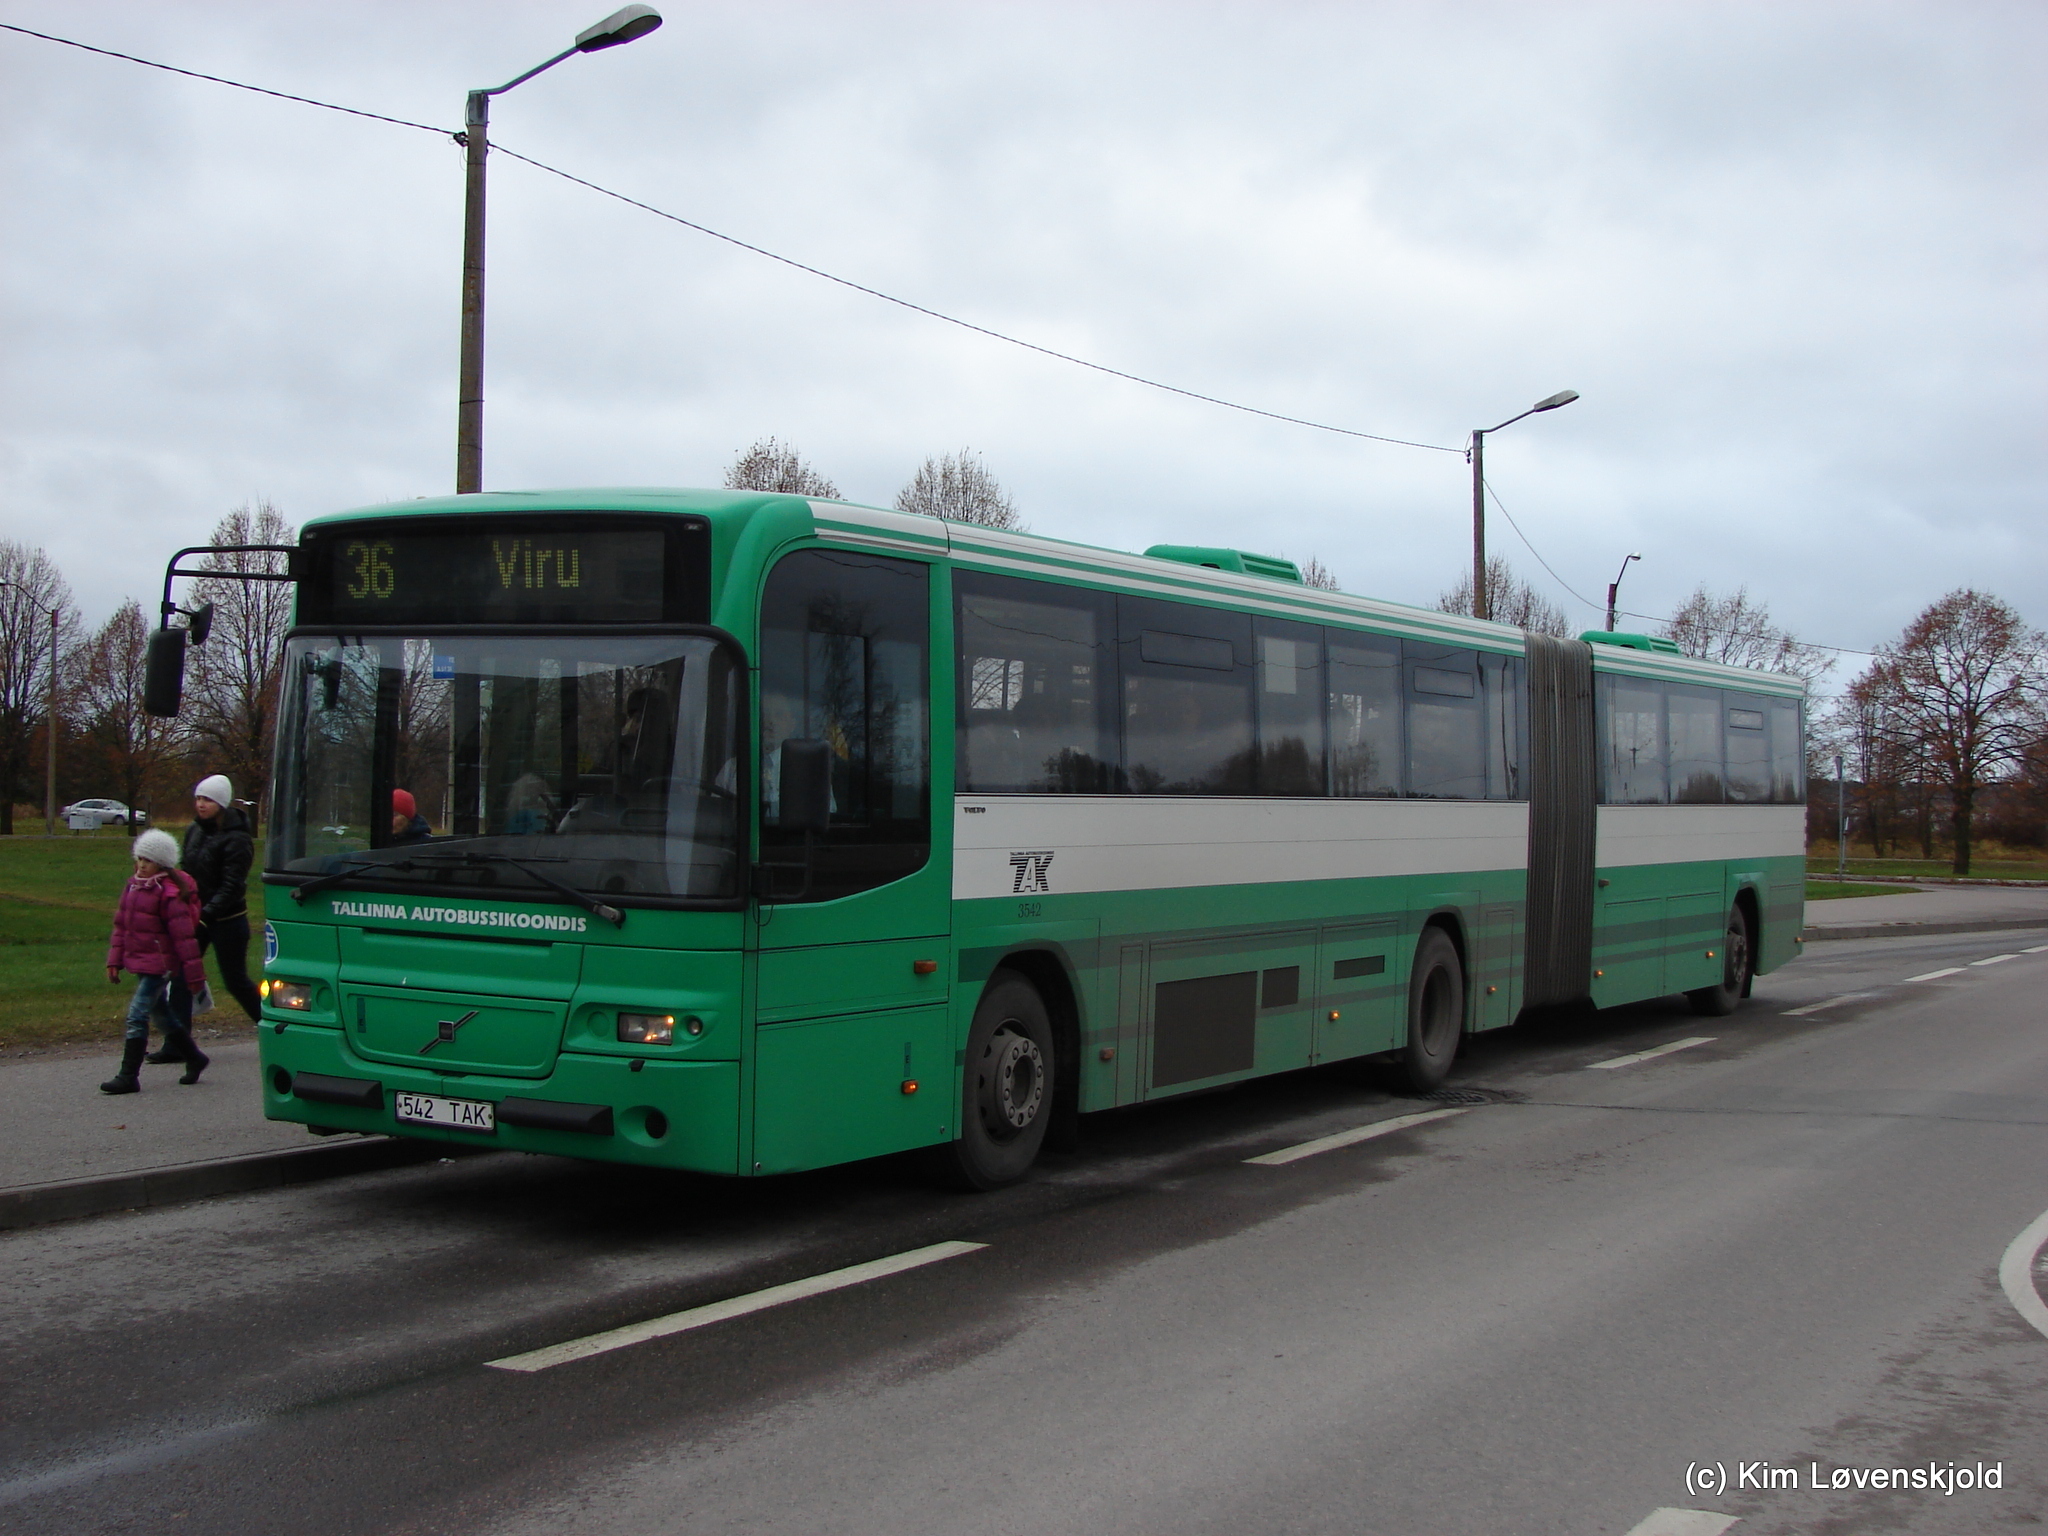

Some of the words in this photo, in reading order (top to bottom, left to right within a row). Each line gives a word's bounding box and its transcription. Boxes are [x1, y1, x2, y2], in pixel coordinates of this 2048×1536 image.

[347, 541, 394, 598] 36
[493, 540, 579, 588] Viru
[1009, 855, 1054, 893] TAK
[332, 901, 407, 920] TALLINNA
[411, 907, 587, 932] AUTOBUSSIKOONDIS
[1018, 903, 1042, 918] 3542
[403, 1096, 434, 1119] 542
[449, 1101, 487, 1126] TAK
